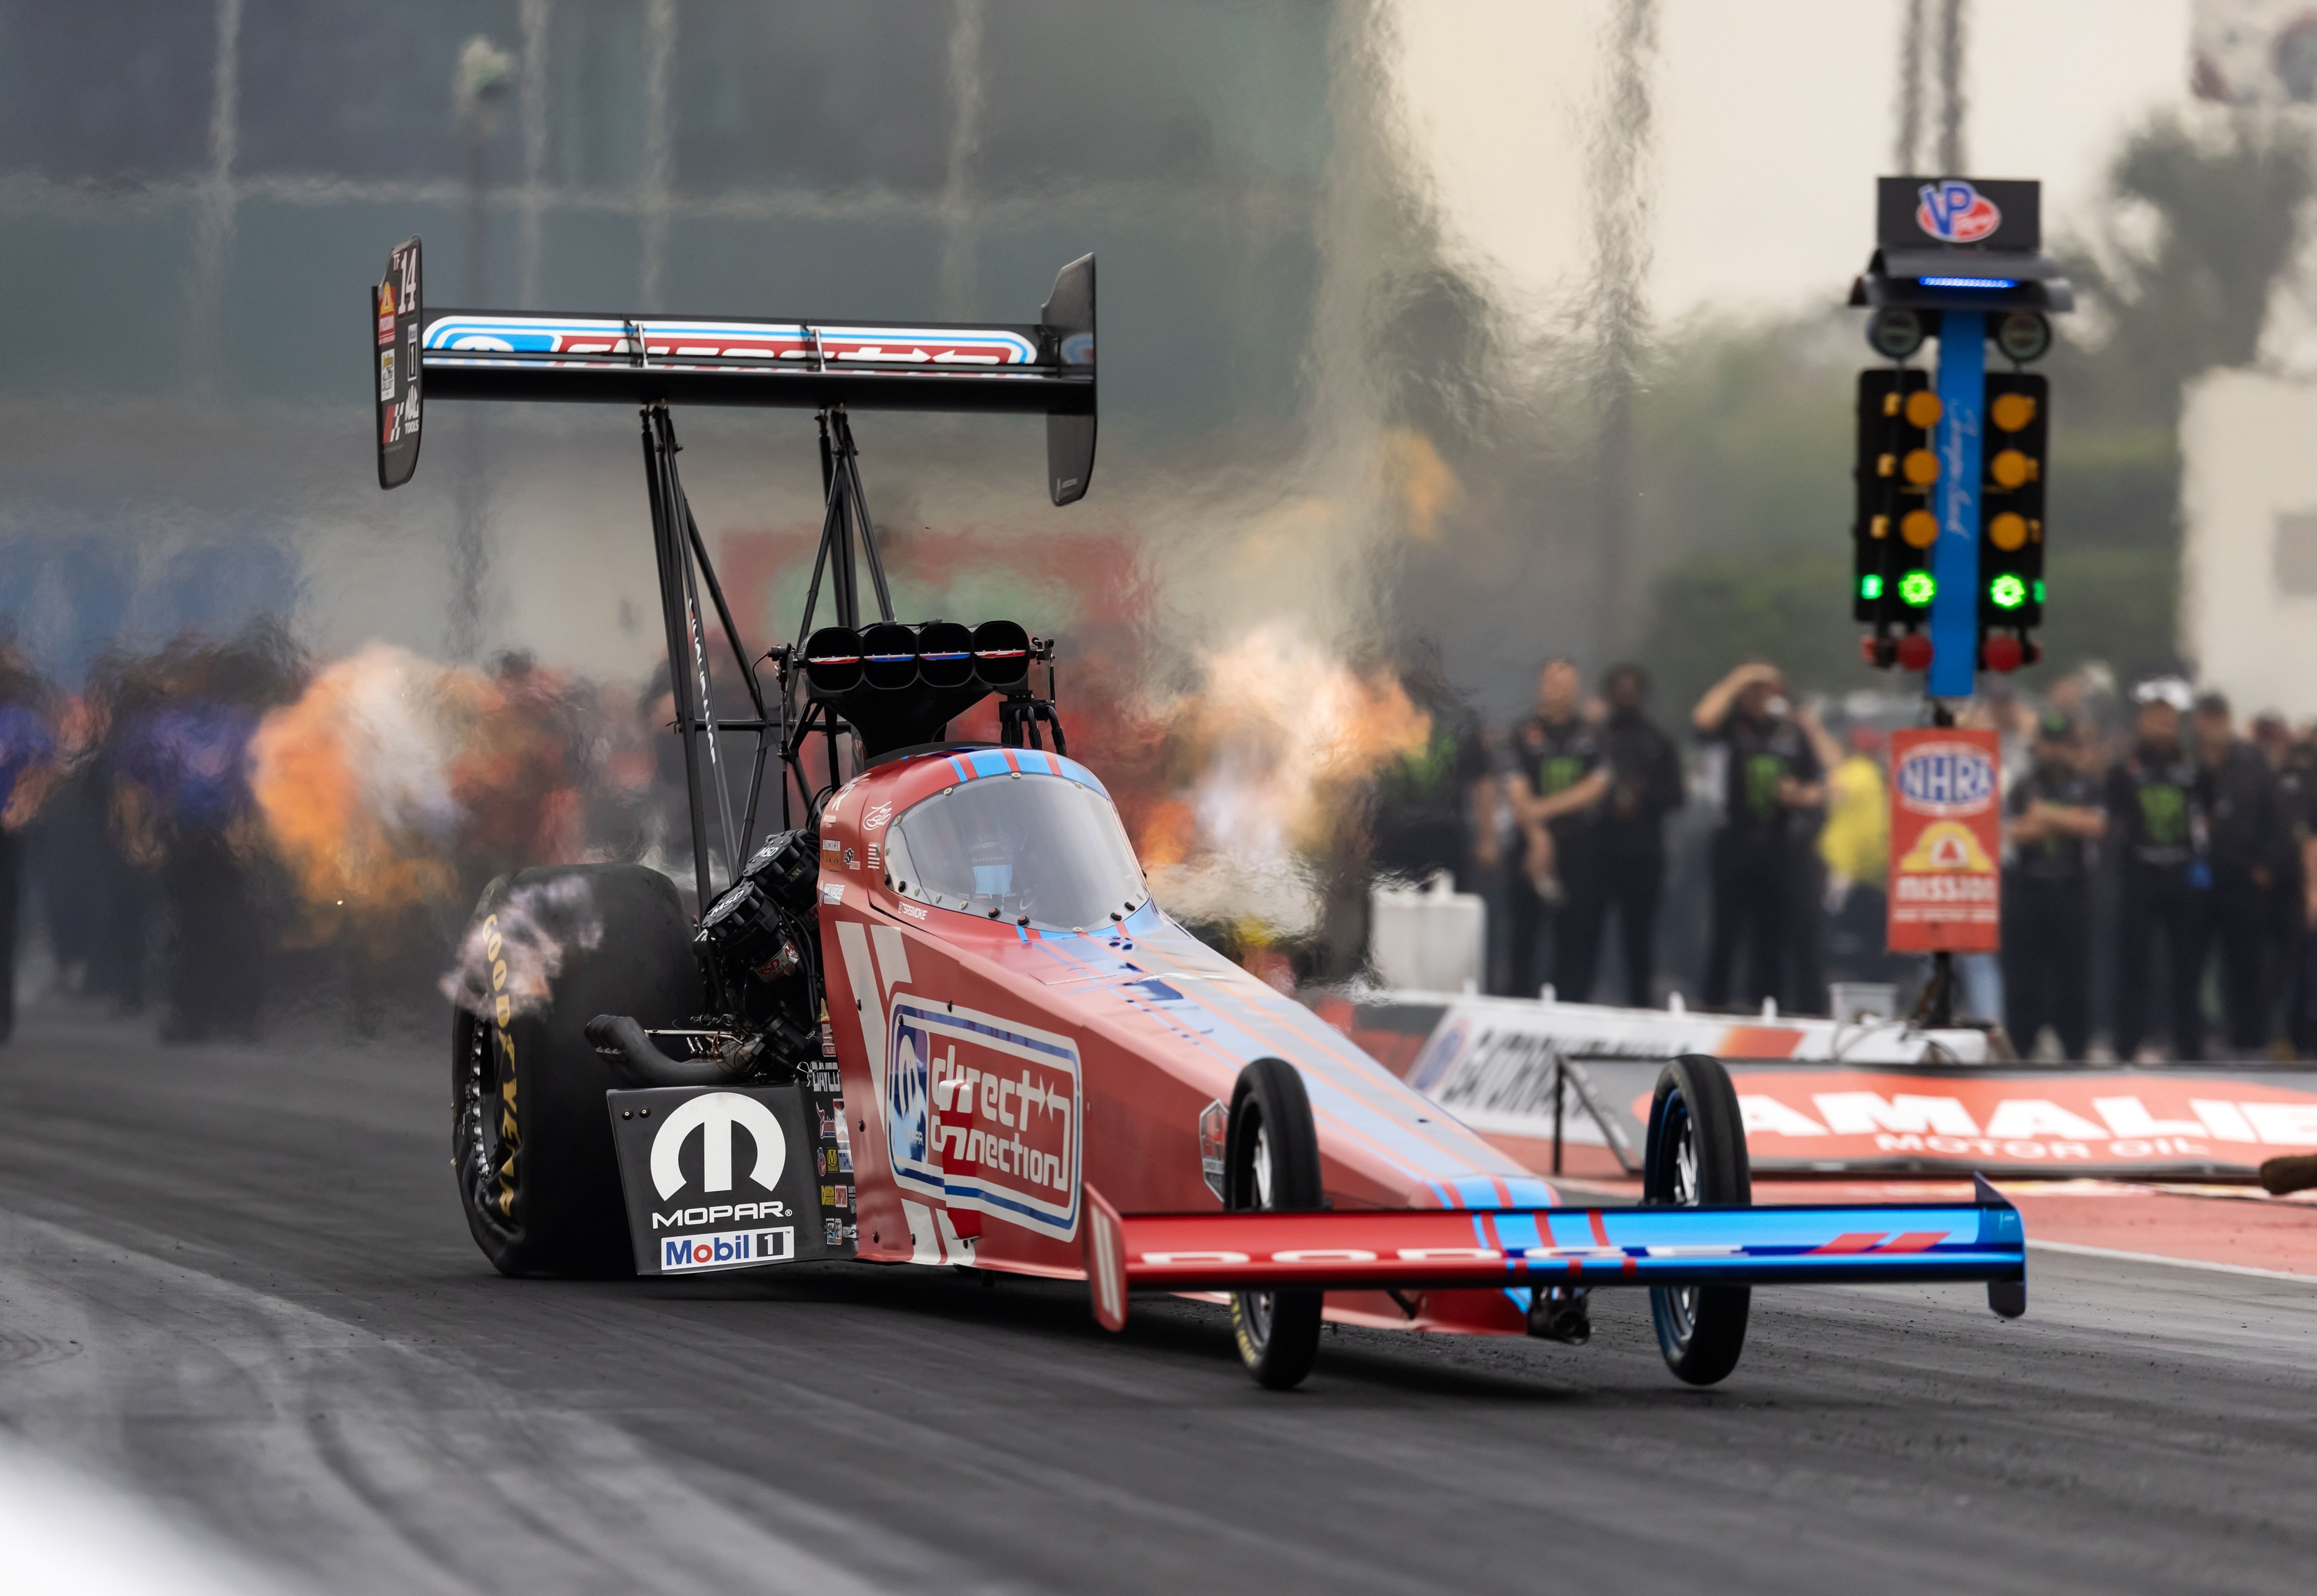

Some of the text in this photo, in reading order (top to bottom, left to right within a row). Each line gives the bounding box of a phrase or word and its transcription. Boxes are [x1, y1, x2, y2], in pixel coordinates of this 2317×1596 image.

[1918, 181, 1976, 236] VP
[398, 247, 417, 315] 14
[404, 419, 419, 435] TOOLS
[1900, 754, 1993, 804] NHRA
[755, 847, 779, 858] MSD
[710, 890, 745, 918] MSD
[1736, 1091, 2317, 1147] AMALIE
[1875, 1133, 2209, 1159] MOTOR OIL
[652, 1201, 784, 1229] MOPAR
[666, 1234, 749, 1266] Mobil
[764, 1234, 773, 1255] 1
